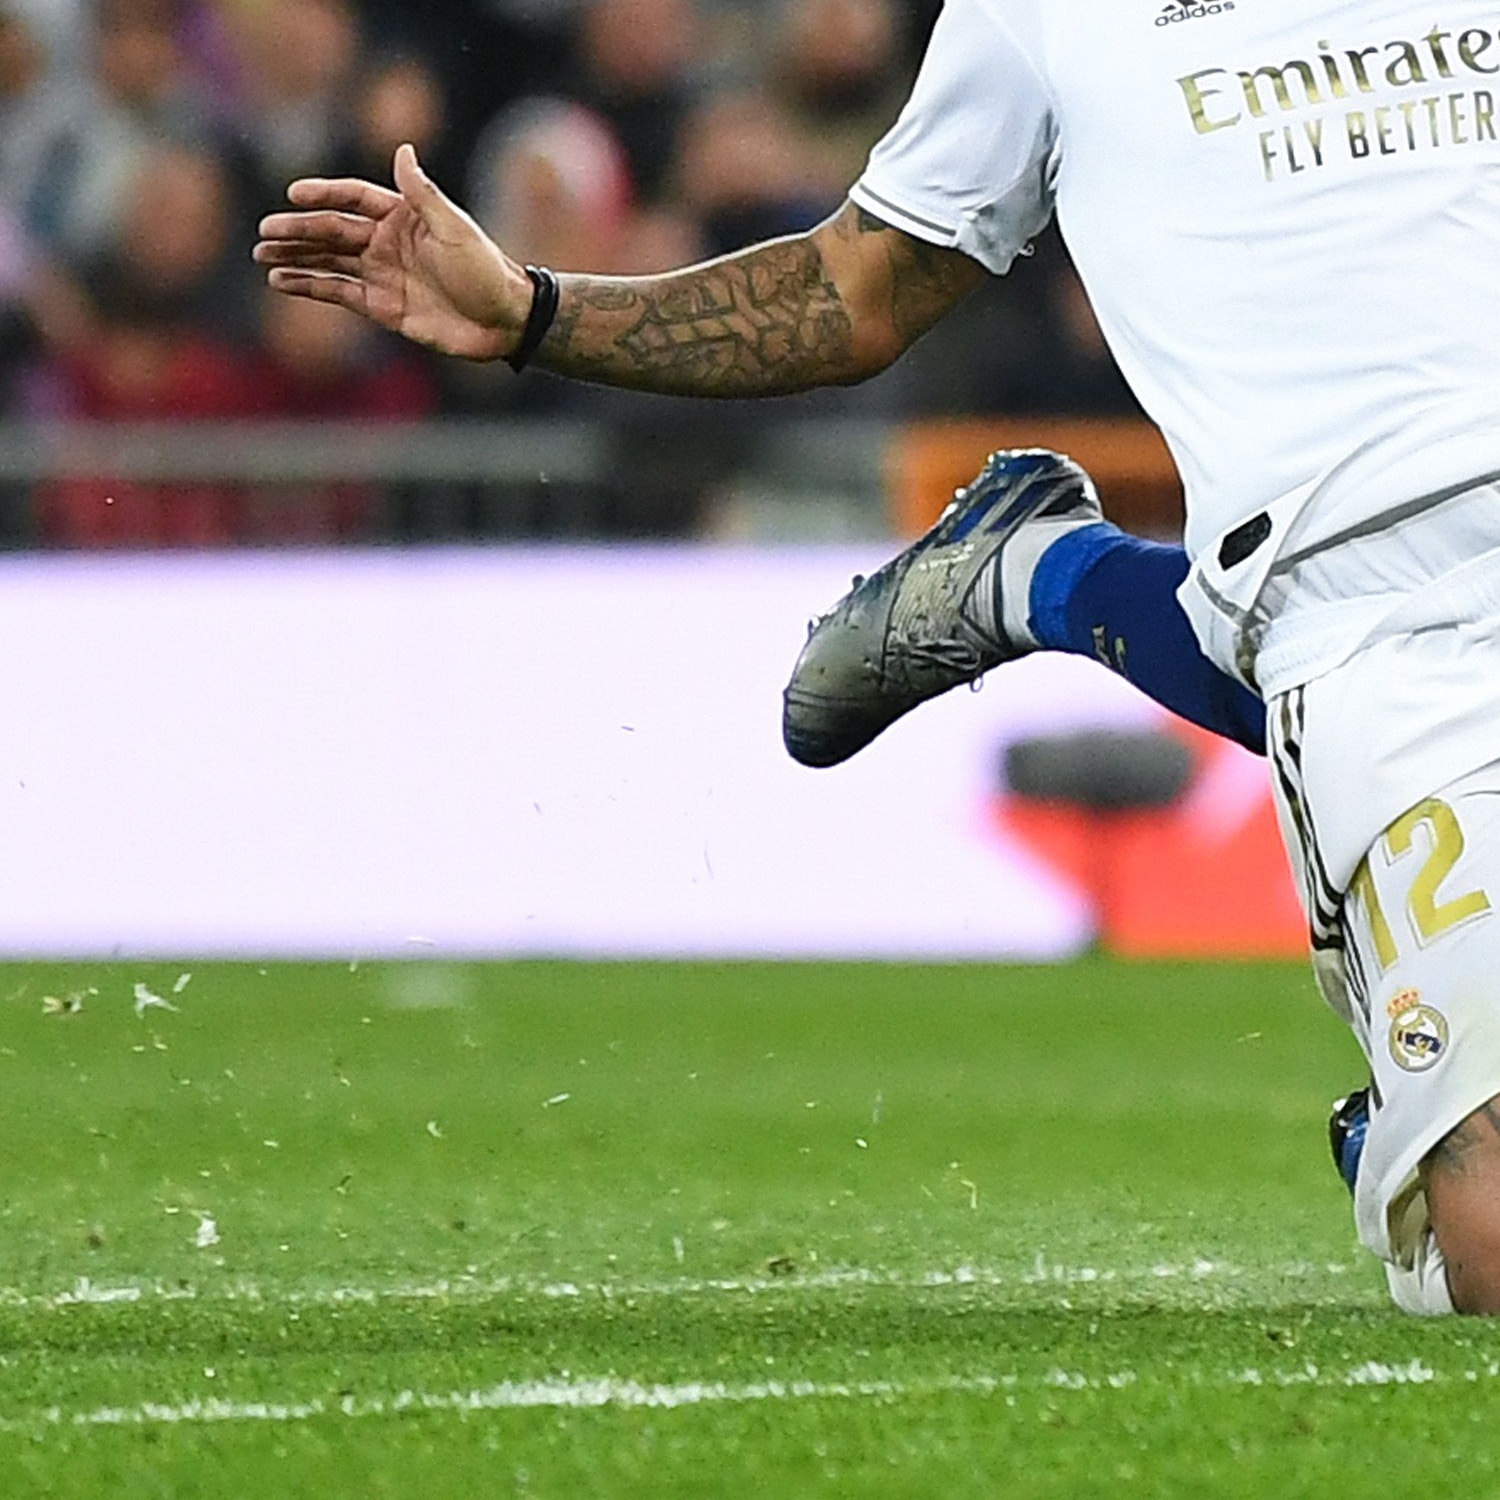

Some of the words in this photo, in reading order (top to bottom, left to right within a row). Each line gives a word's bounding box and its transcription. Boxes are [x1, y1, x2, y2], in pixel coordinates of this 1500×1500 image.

[1154, 0, 1236, 28] adidas
[1258, 112, 1326, 182] FLY
[1345, 89, 1498, 160] BETTER
[1350, 797, 1494, 978] 12
